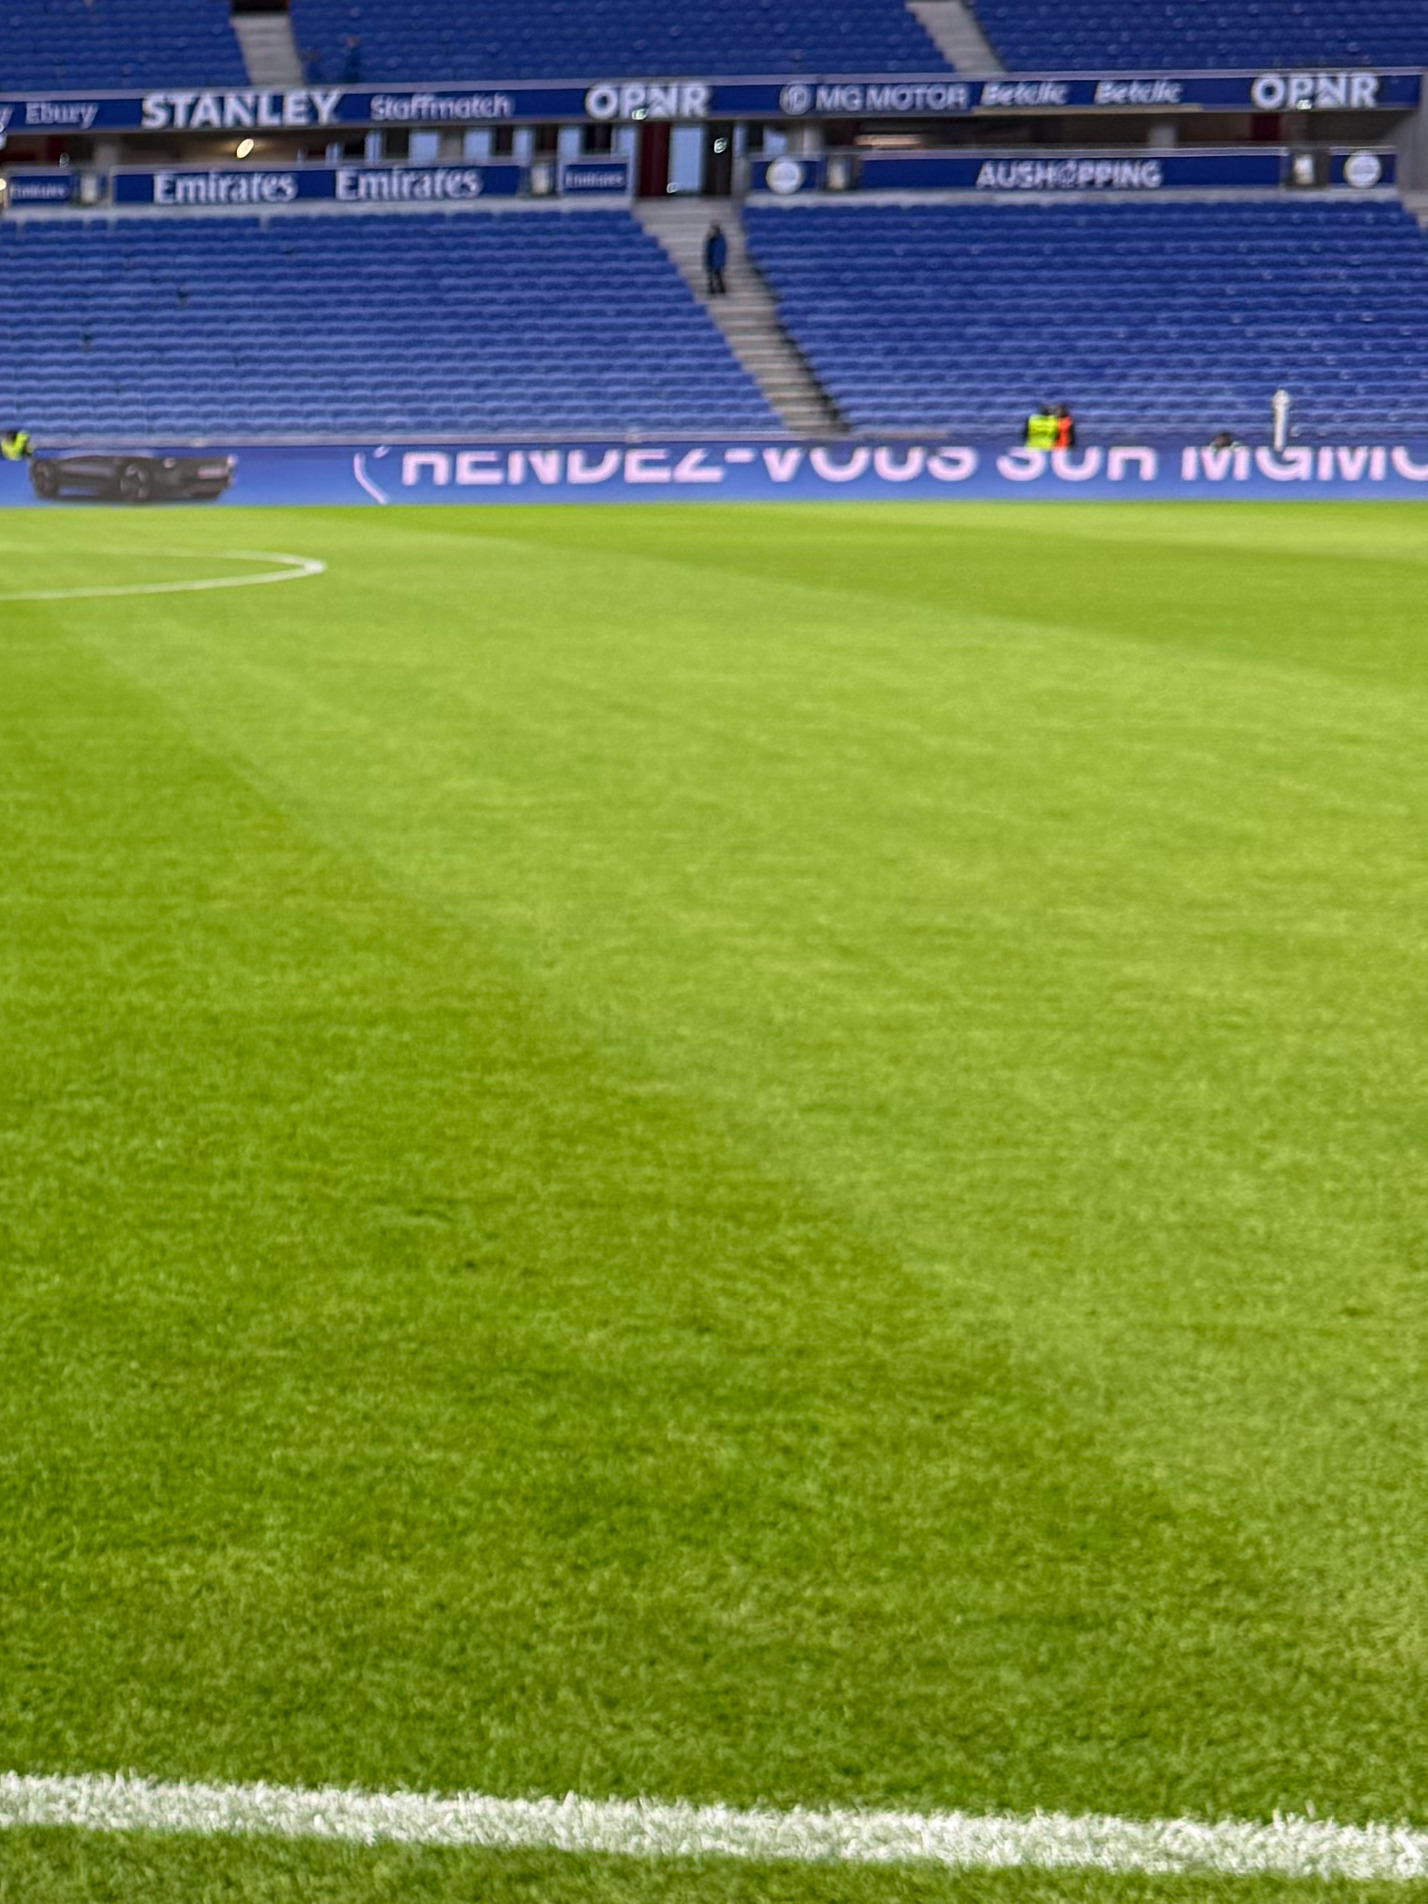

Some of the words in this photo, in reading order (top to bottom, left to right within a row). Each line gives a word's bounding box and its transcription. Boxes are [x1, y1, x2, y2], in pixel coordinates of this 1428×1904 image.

[369, 92, 514, 122] Staffmatch
[815, 84, 864, 112] MG
[866, 82, 970, 112] MOTOR
[980, 80, 1072, 108] Betclic
[1094, 79, 1185, 106] Betclic
[25, 102, 99, 128] Ebury
[141, 88, 342, 129] STANLEY
[152, 171, 299, 204] Emirates
[334, 168, 485, 201] Emirates
